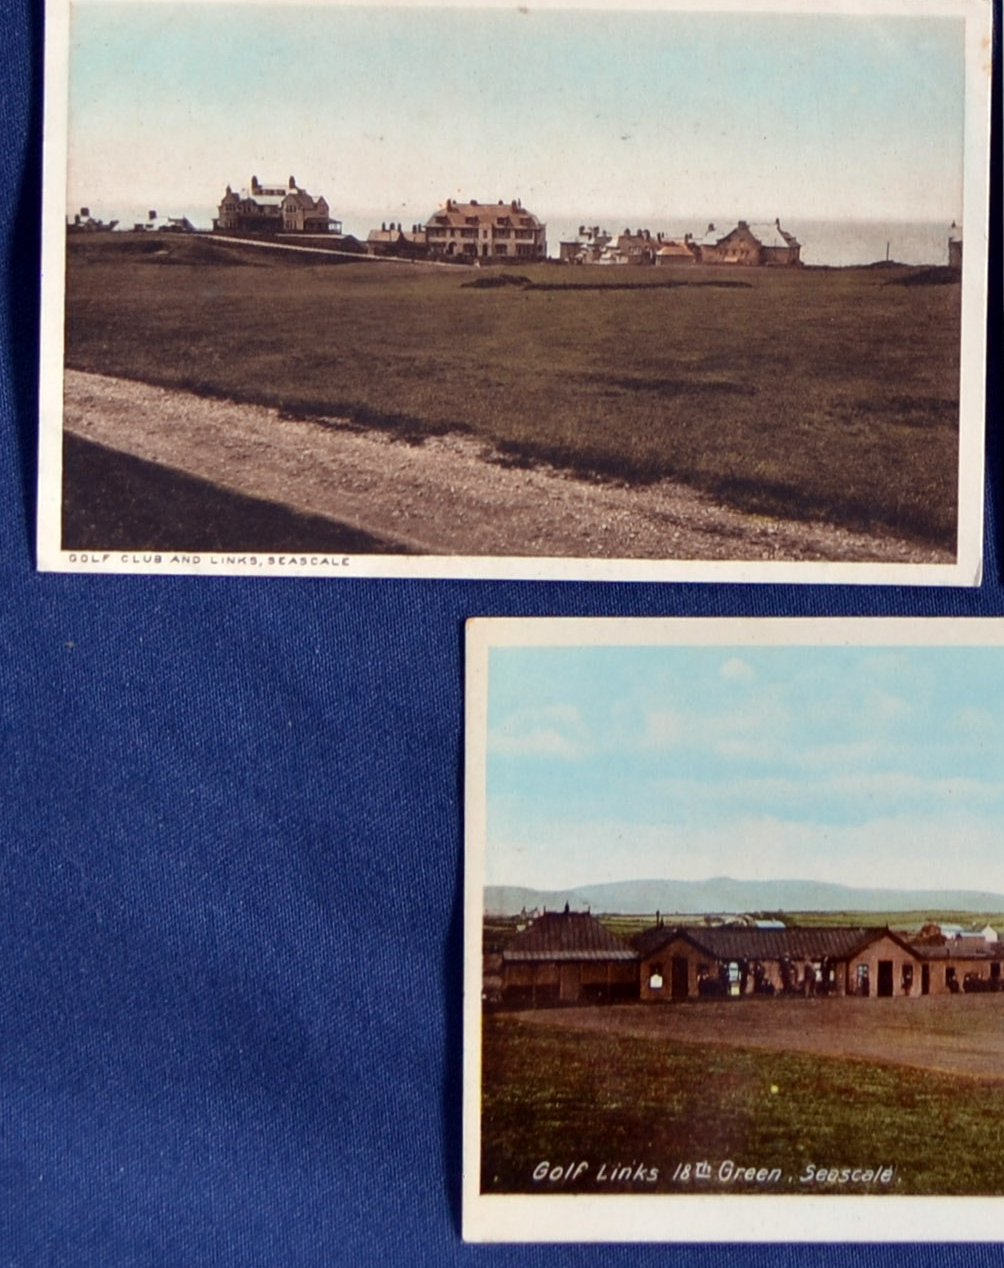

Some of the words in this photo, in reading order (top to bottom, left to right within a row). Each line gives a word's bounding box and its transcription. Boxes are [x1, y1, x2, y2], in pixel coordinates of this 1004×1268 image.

[68, 554, 111, 564] GOLF
[121, 555, 162, 564] CLUB
[170, 555, 201, 565] AND
[210, 556, 263, 567] LINKS,
[268, 557, 350, 567] SEASCALE
[532, 1160, 588, 1181] Golf
[597, 1161, 659, 1182] Links
